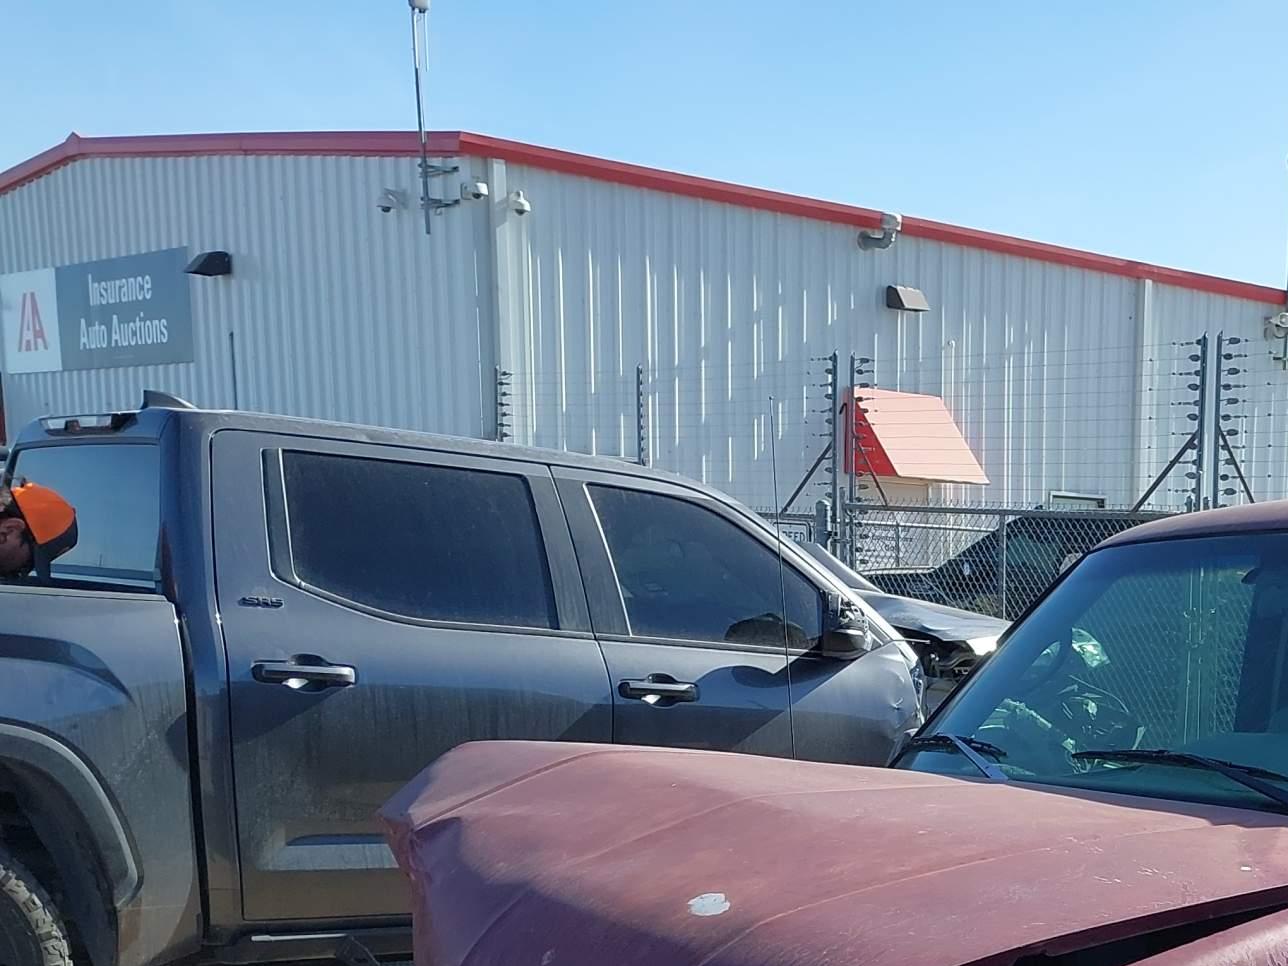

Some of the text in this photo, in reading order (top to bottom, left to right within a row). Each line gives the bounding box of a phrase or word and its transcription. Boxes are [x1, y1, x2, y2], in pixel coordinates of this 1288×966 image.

[87, 273, 152, 306] Insurance
[79, 311, 169, 349] Auto Auctions
